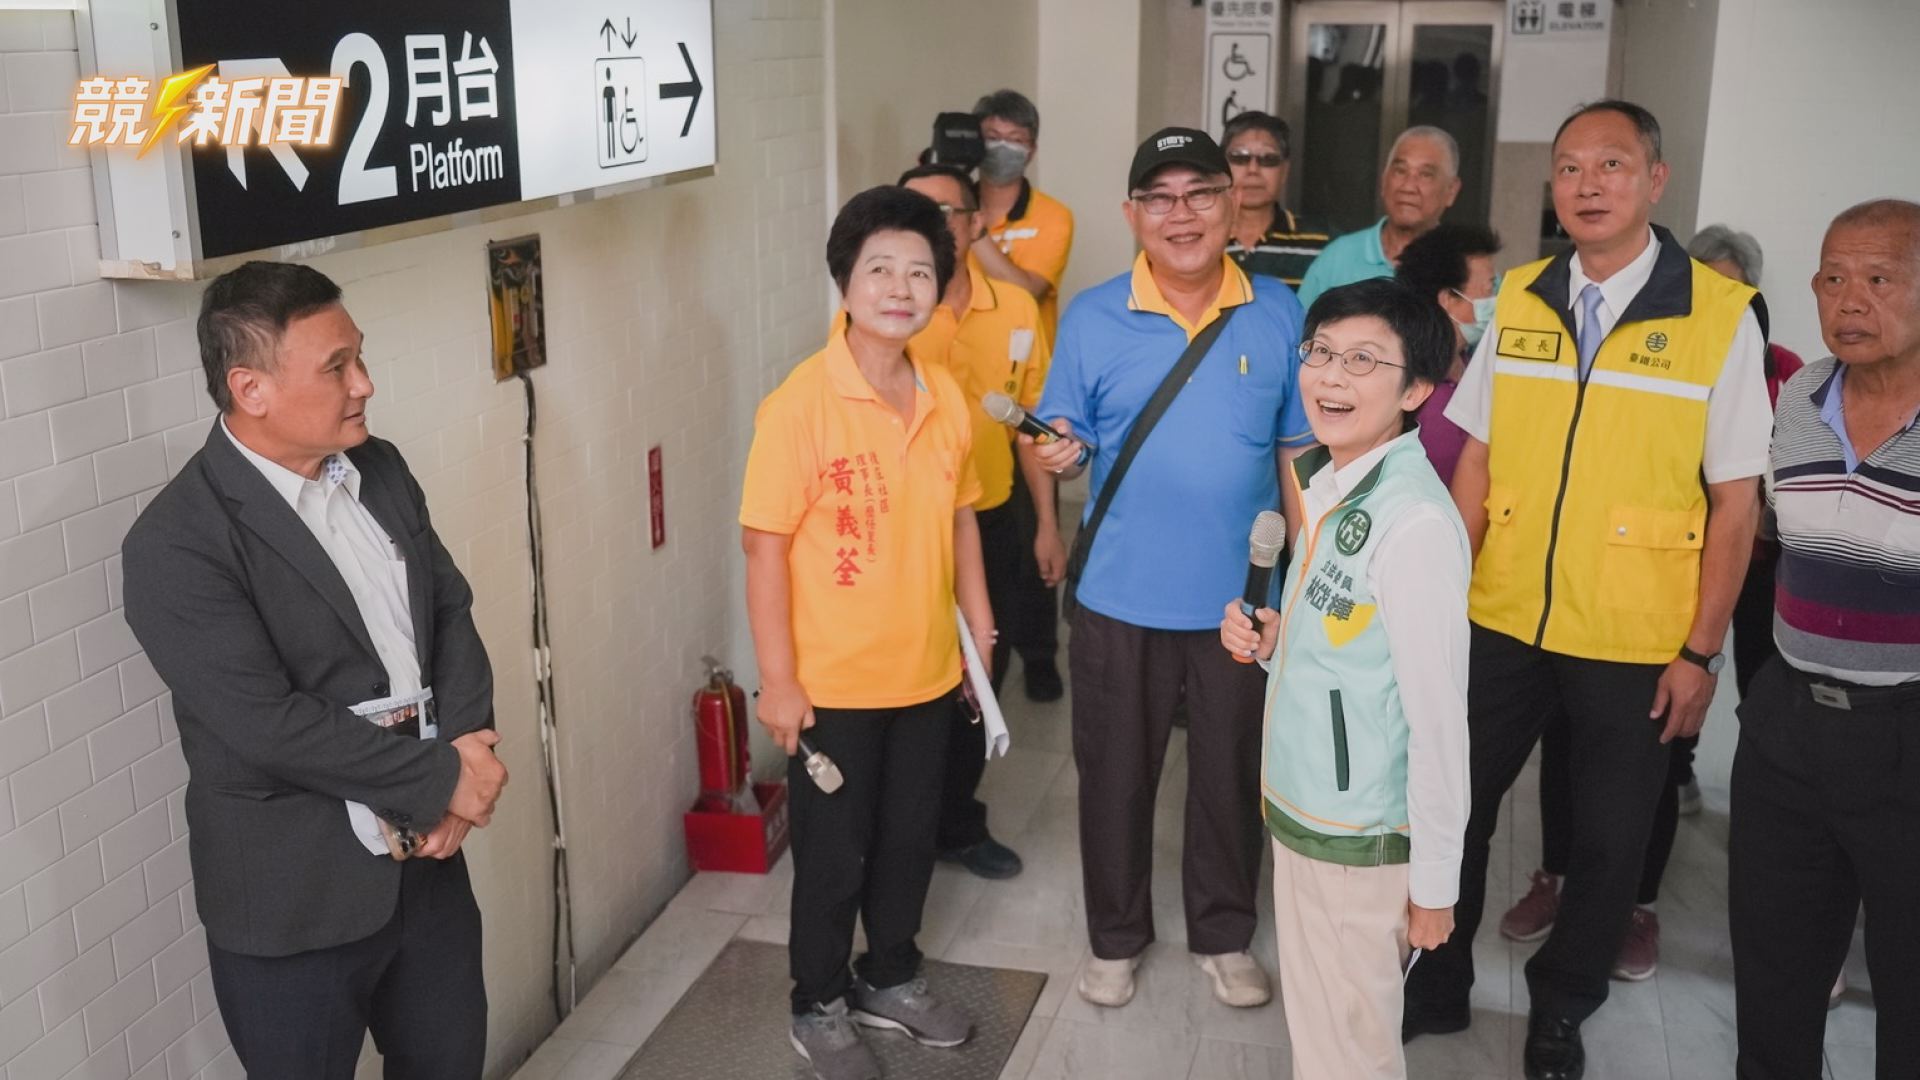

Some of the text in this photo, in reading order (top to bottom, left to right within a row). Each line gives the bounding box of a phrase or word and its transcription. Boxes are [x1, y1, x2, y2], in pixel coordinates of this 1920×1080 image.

[404, 31, 500, 128] 月台
[330, 32, 399, 206] 2
[409, 138, 504, 192] Platform
[1513, 336, 1549, 353] 處長
